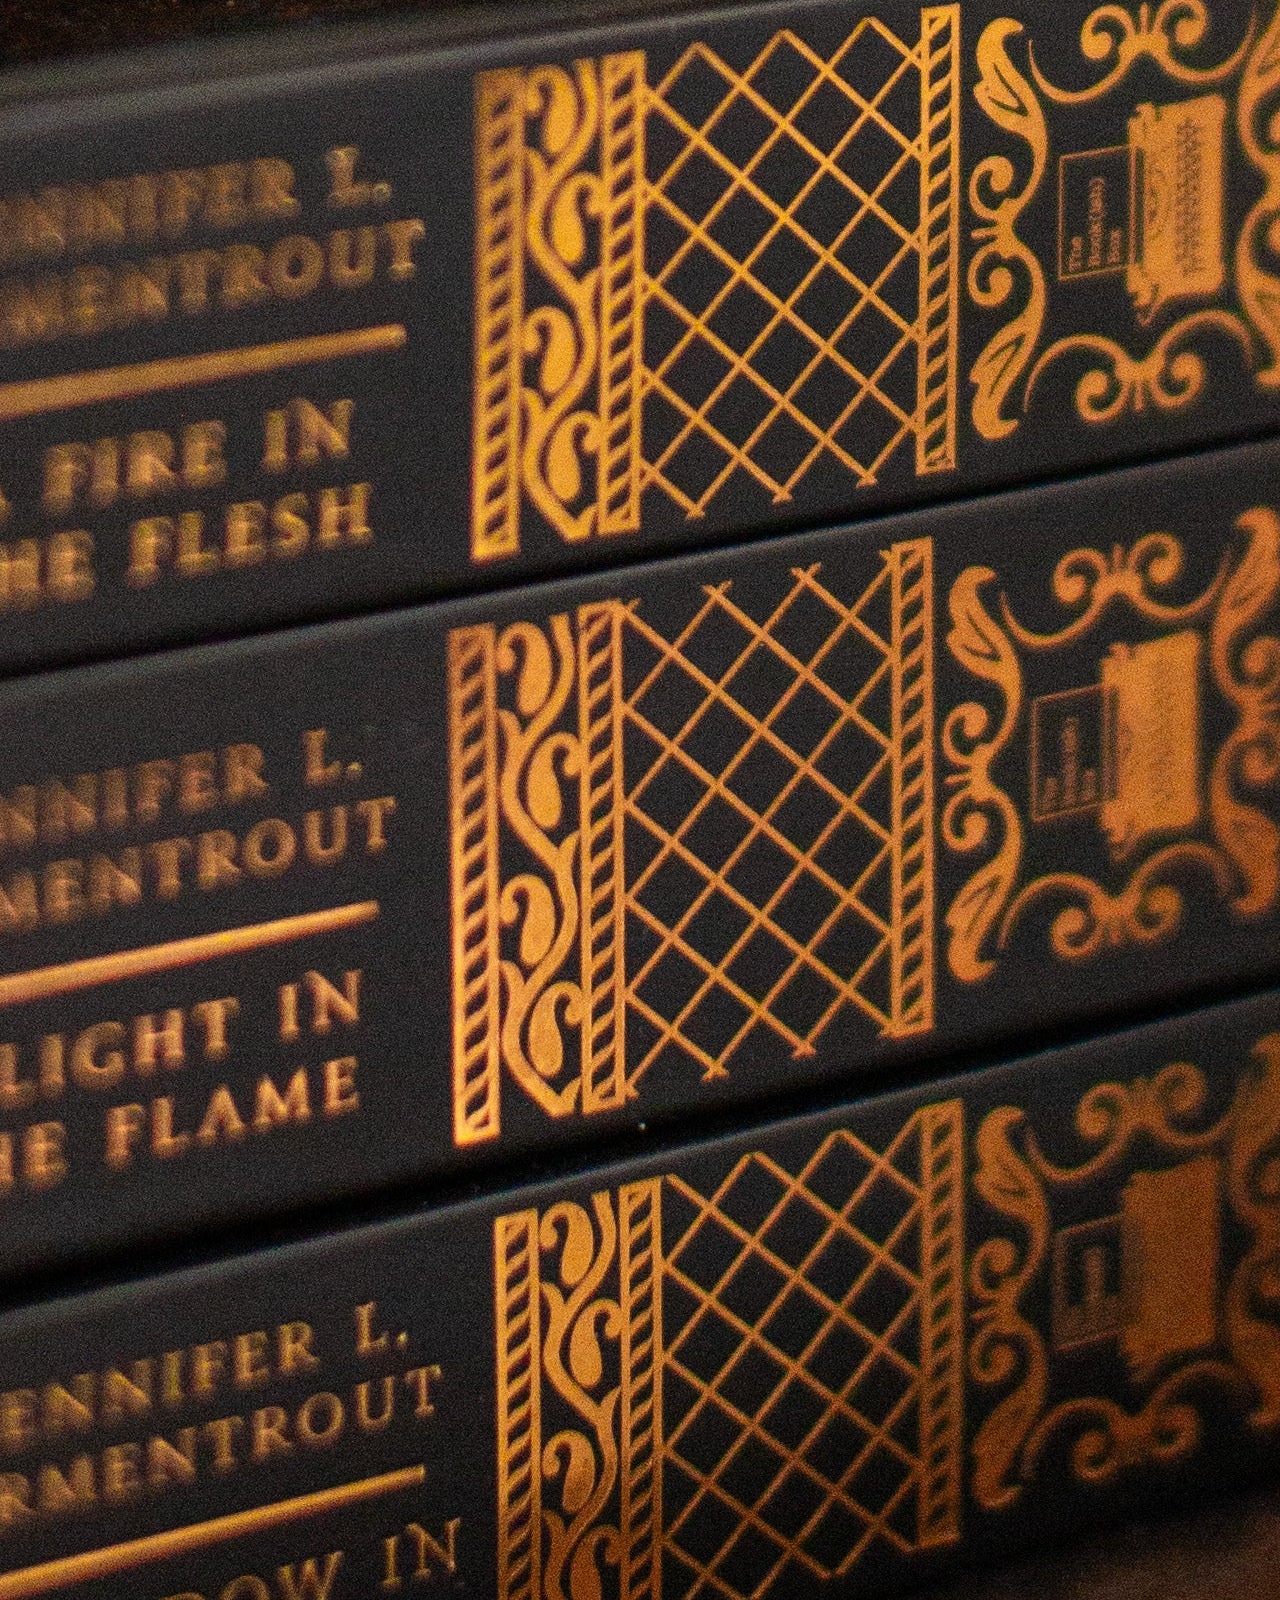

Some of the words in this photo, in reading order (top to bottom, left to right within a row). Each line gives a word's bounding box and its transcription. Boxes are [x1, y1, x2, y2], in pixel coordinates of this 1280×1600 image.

[328, 146, 391, 206] L.
[43, 421, 226, 509] FIRE
[263, 399, 354, 472] IN
[129, 482, 373, 586] FLESH
[302, 728, 361, 785] L.
[278, 970, 361, 1041] IN
[107, 1056, 360, 1169] FLAME
[354, 1302, 409, 1356] L.
[383, 1518, 462, 1588] IN
